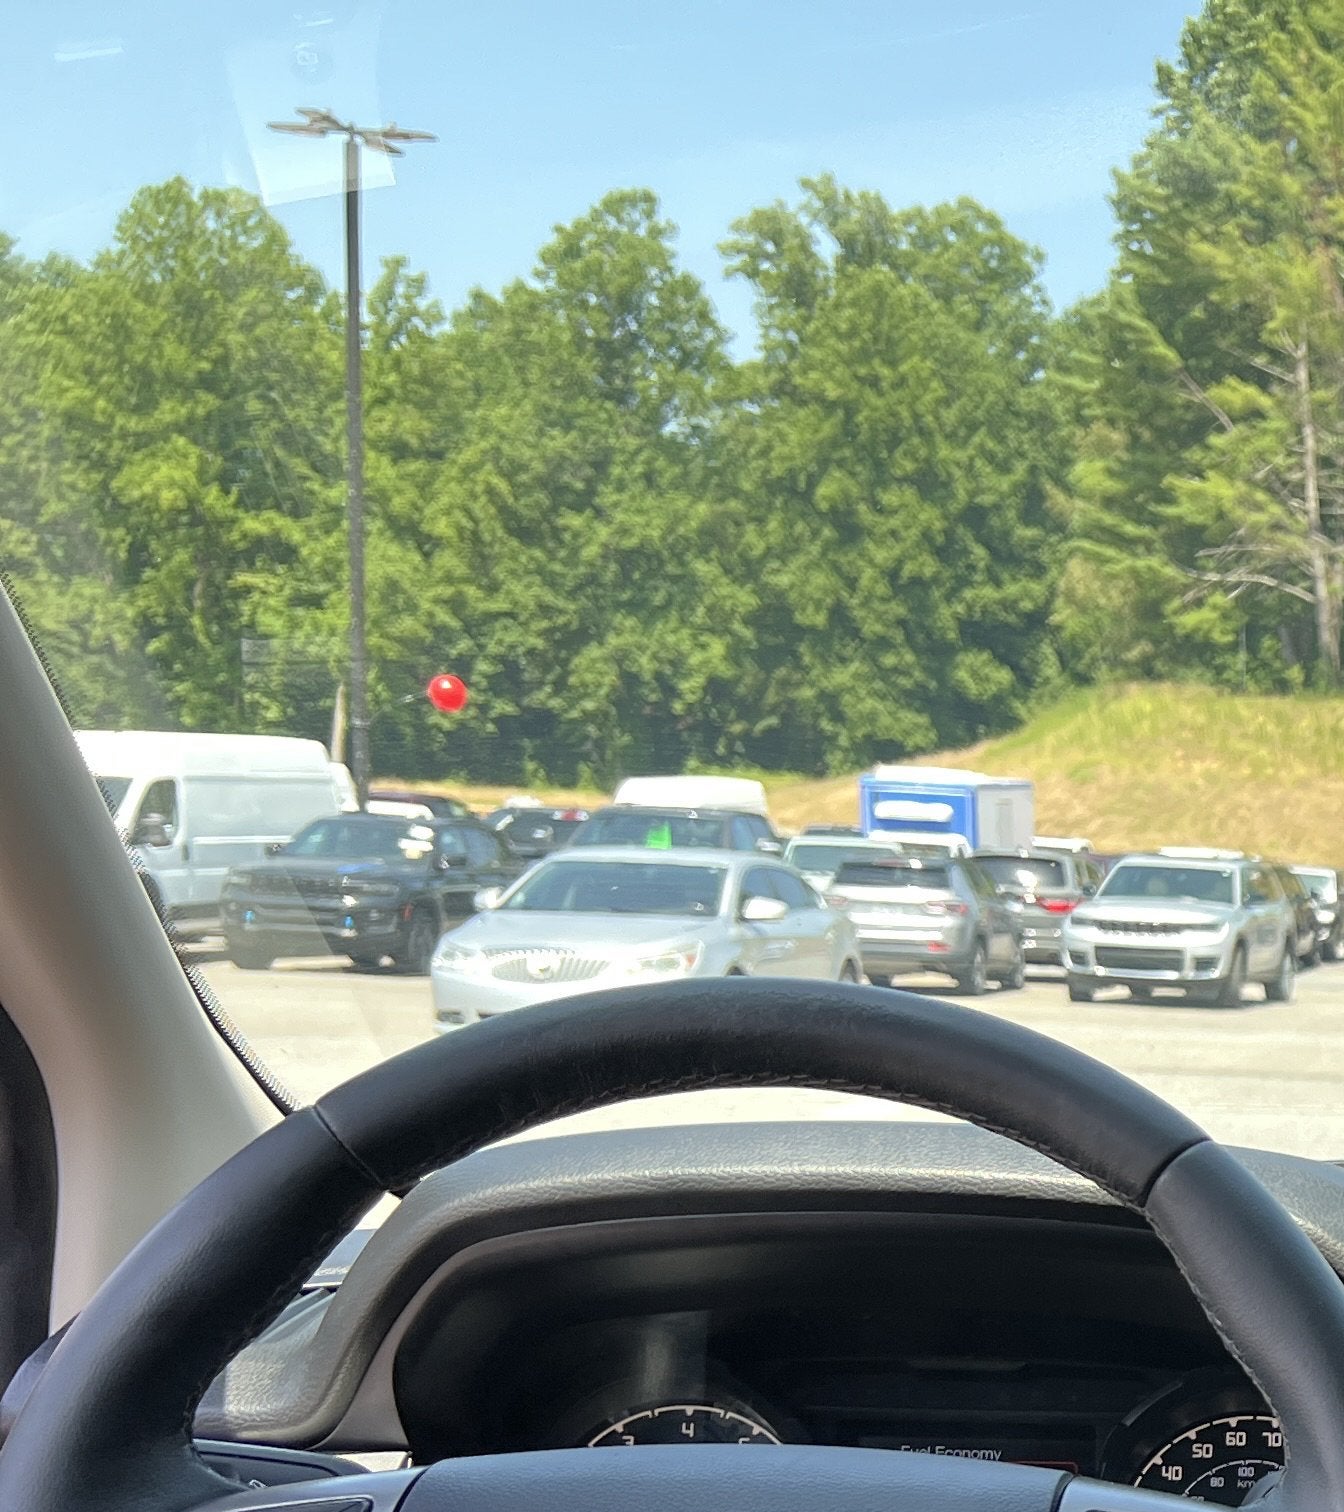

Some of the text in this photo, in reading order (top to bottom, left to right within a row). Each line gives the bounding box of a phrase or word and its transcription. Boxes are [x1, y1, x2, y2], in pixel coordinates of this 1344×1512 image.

[680, 1422, 695, 1438] 4
[1225, 1431, 1247, 1447] 60
[1261, 1431, 1283, 1448] 70
[1191, 1443, 1214, 1459] 50
[1161, 1465, 1183, 1482] 40
[1237, 1466, 1255, 1478] 100
